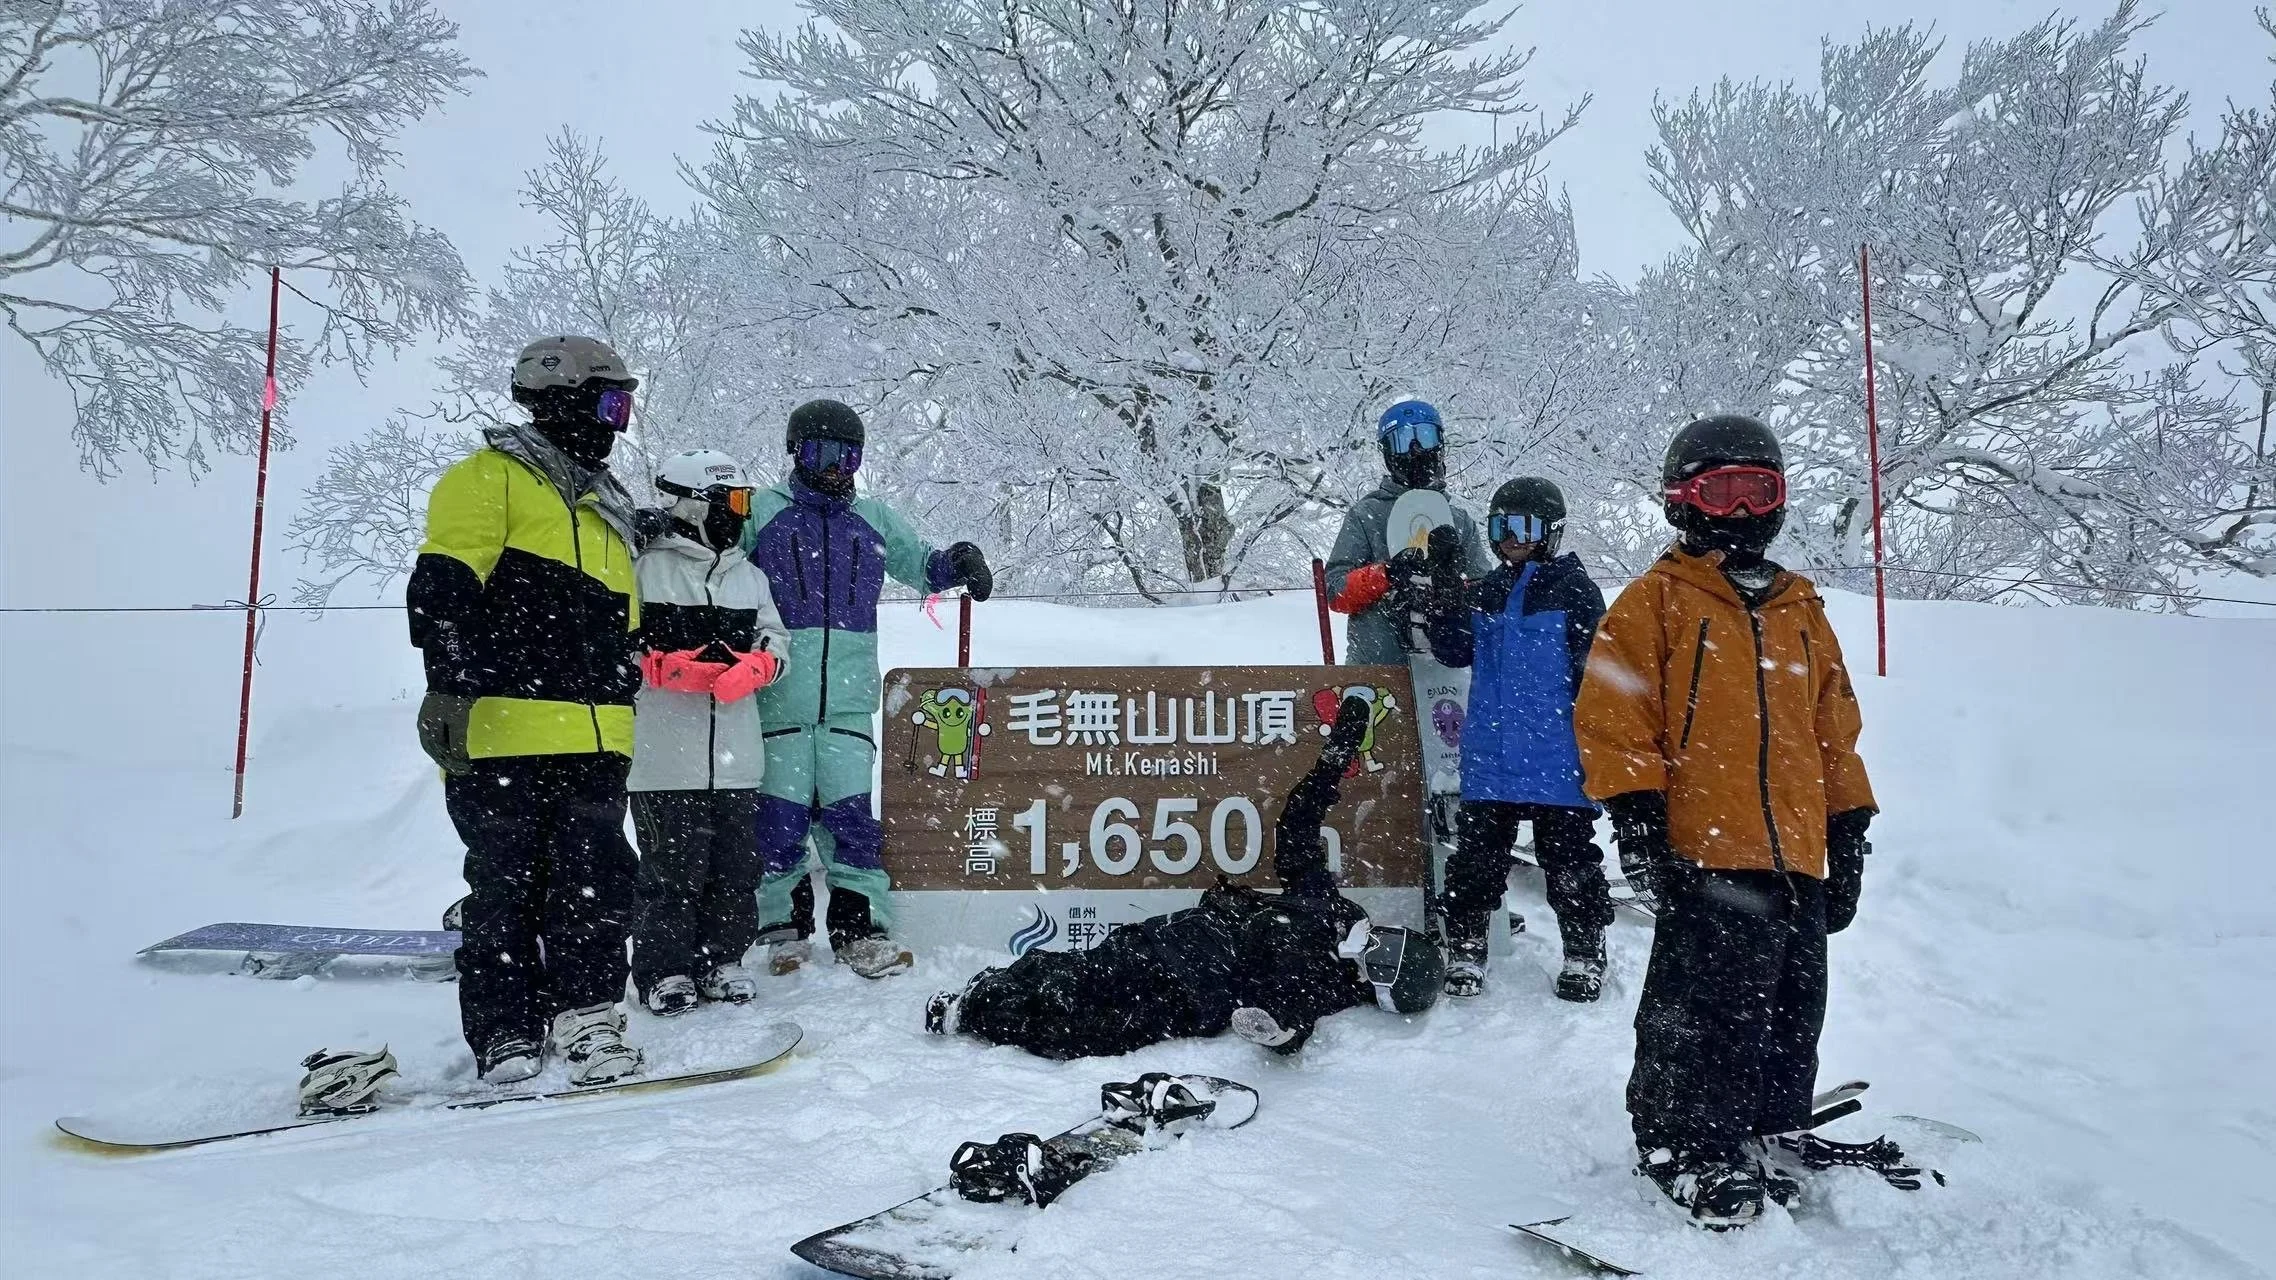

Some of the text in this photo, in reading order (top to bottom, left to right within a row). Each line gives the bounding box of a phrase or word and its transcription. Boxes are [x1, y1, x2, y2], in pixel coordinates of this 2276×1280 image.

[1006, 690, 1297, 746] 毛無山山頂
[1085, 751, 1218, 776] Mt.Kenashi
[964, 806, 999, 877] 標高
